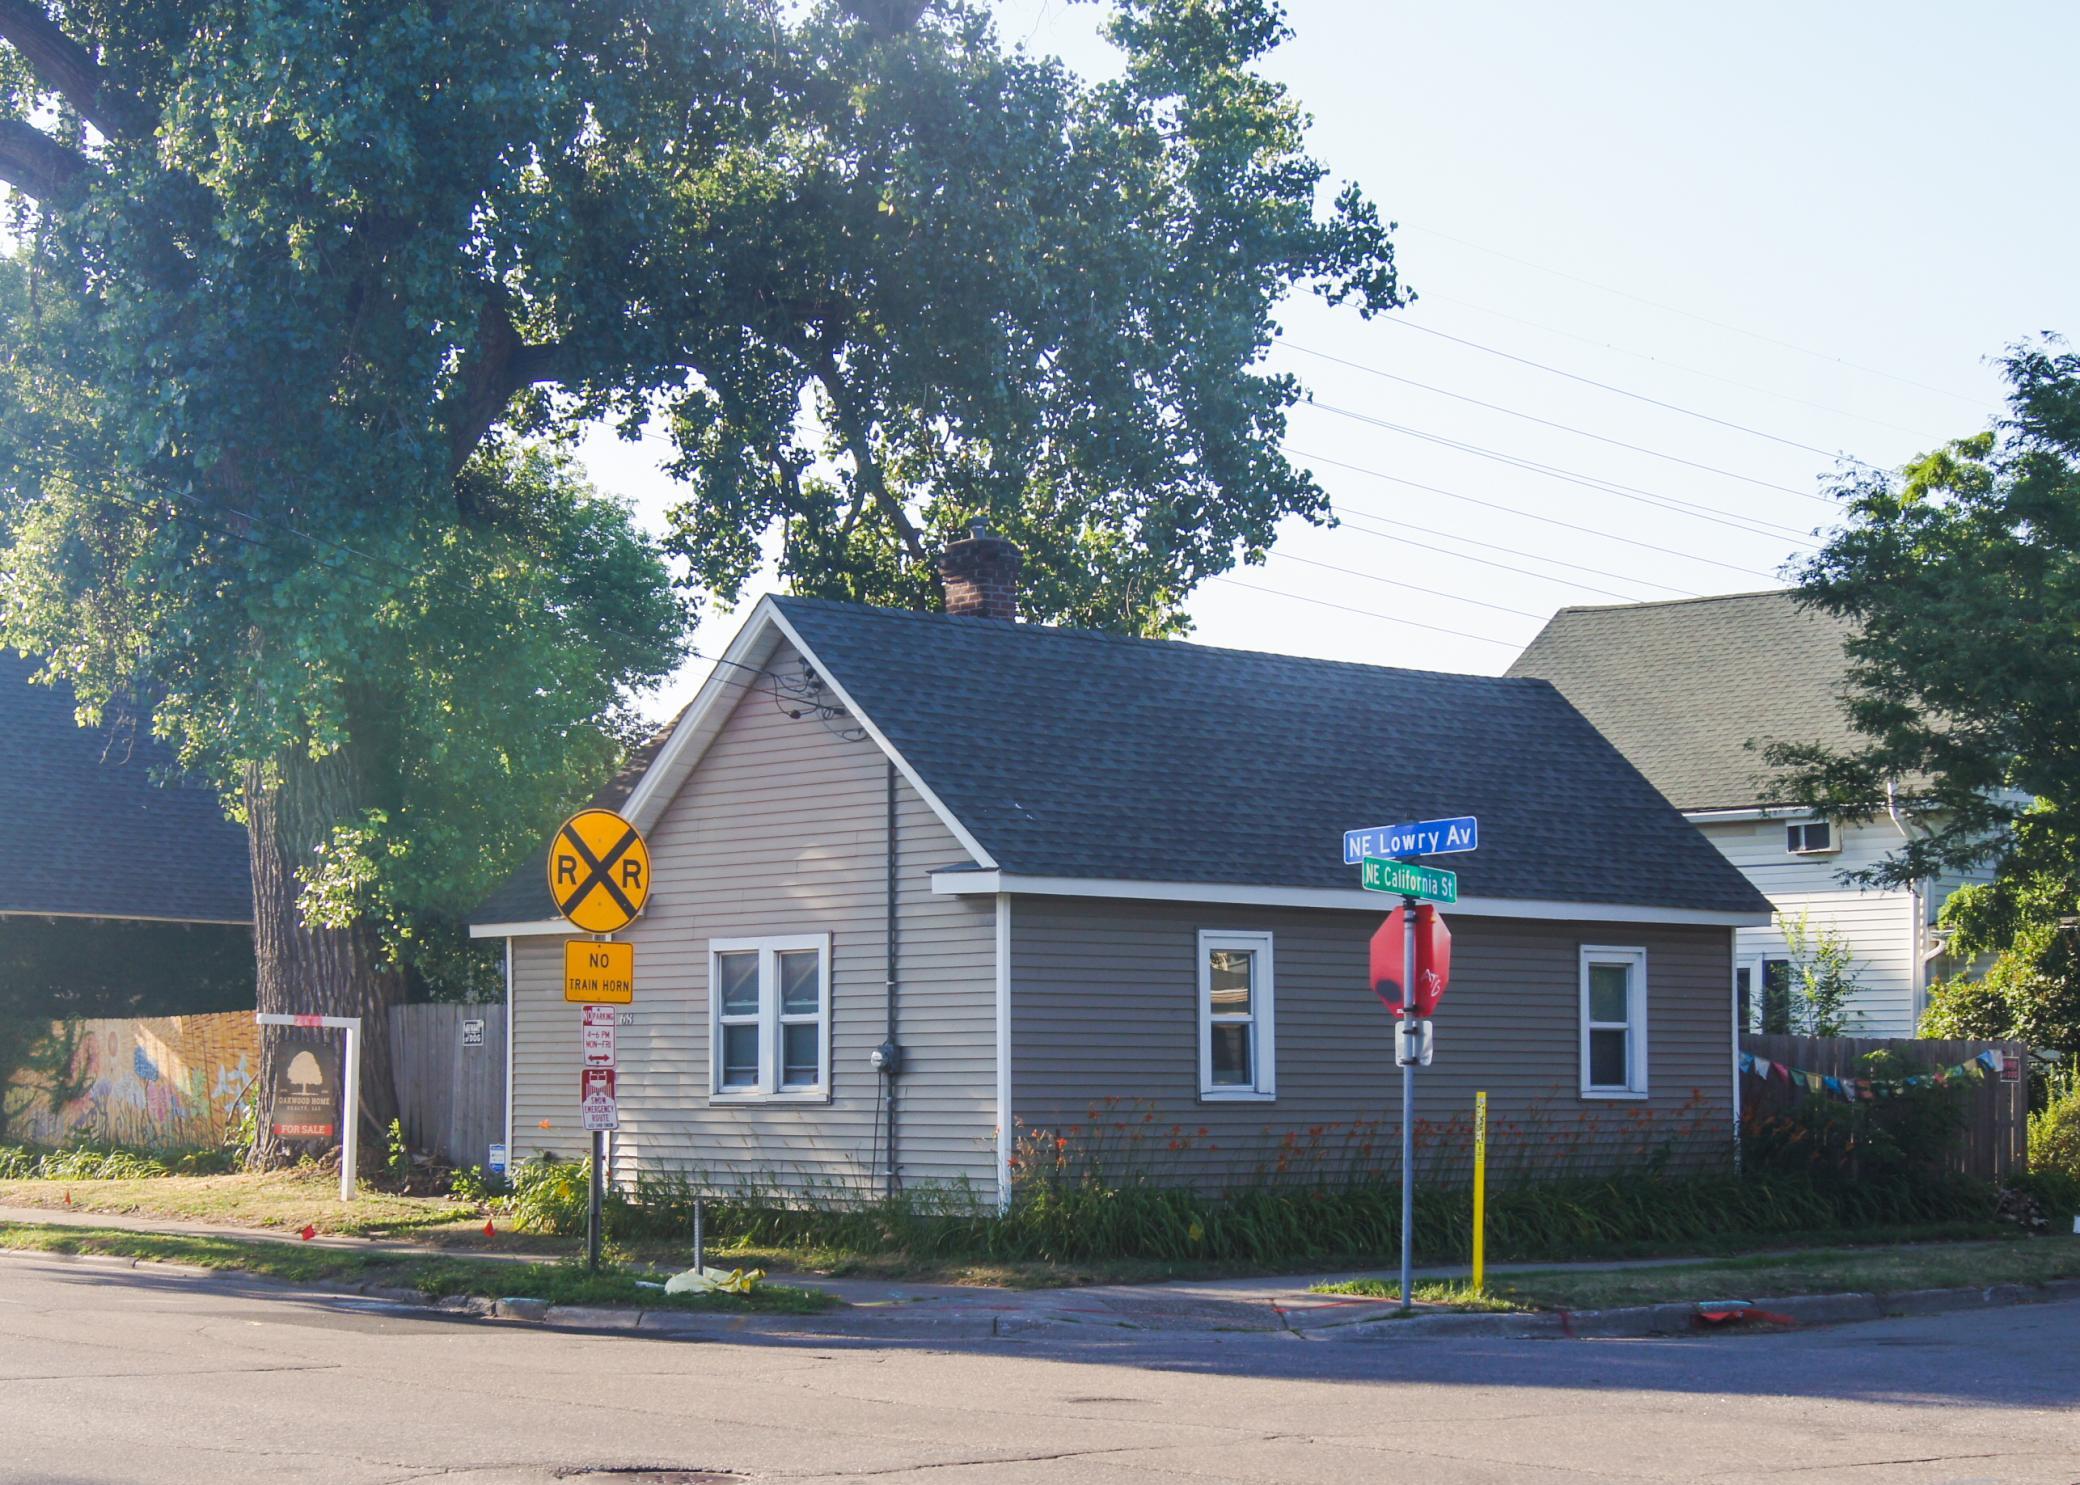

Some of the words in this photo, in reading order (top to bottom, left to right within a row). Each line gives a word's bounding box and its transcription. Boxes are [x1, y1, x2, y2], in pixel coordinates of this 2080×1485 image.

[1349, 835, 1372, 858] NE
[1380, 831, 1439, 854] Lowry
[1446, 824, 1471, 846] Av
[557, 854, 578, 885] R
[622, 858, 642, 889] R
[1365, 863, 1380, 885] NE
[1384, 867, 1438, 895] California
[1441, 877, 1453, 897] St
[589, 953, 609, 968] NO
[569, 978, 598, 991] TRAIN
[602, 980, 629, 992] HORN
[592, 1012, 614, 1021] PARKING
[601, 1030, 610, 1039] PM
[278, 1096, 310, 1105] OAKWOOD
[311, 1097, 330, 1105] HOME
[591, 1096, 606, 1105] SNOW
[584, 1105, 614, 1114] EMERGENCY
[592, 1113, 610, 1122] ROUTE
[281, 1124, 300, 1134] FOR
[301, 1124, 326, 1135] SALE
